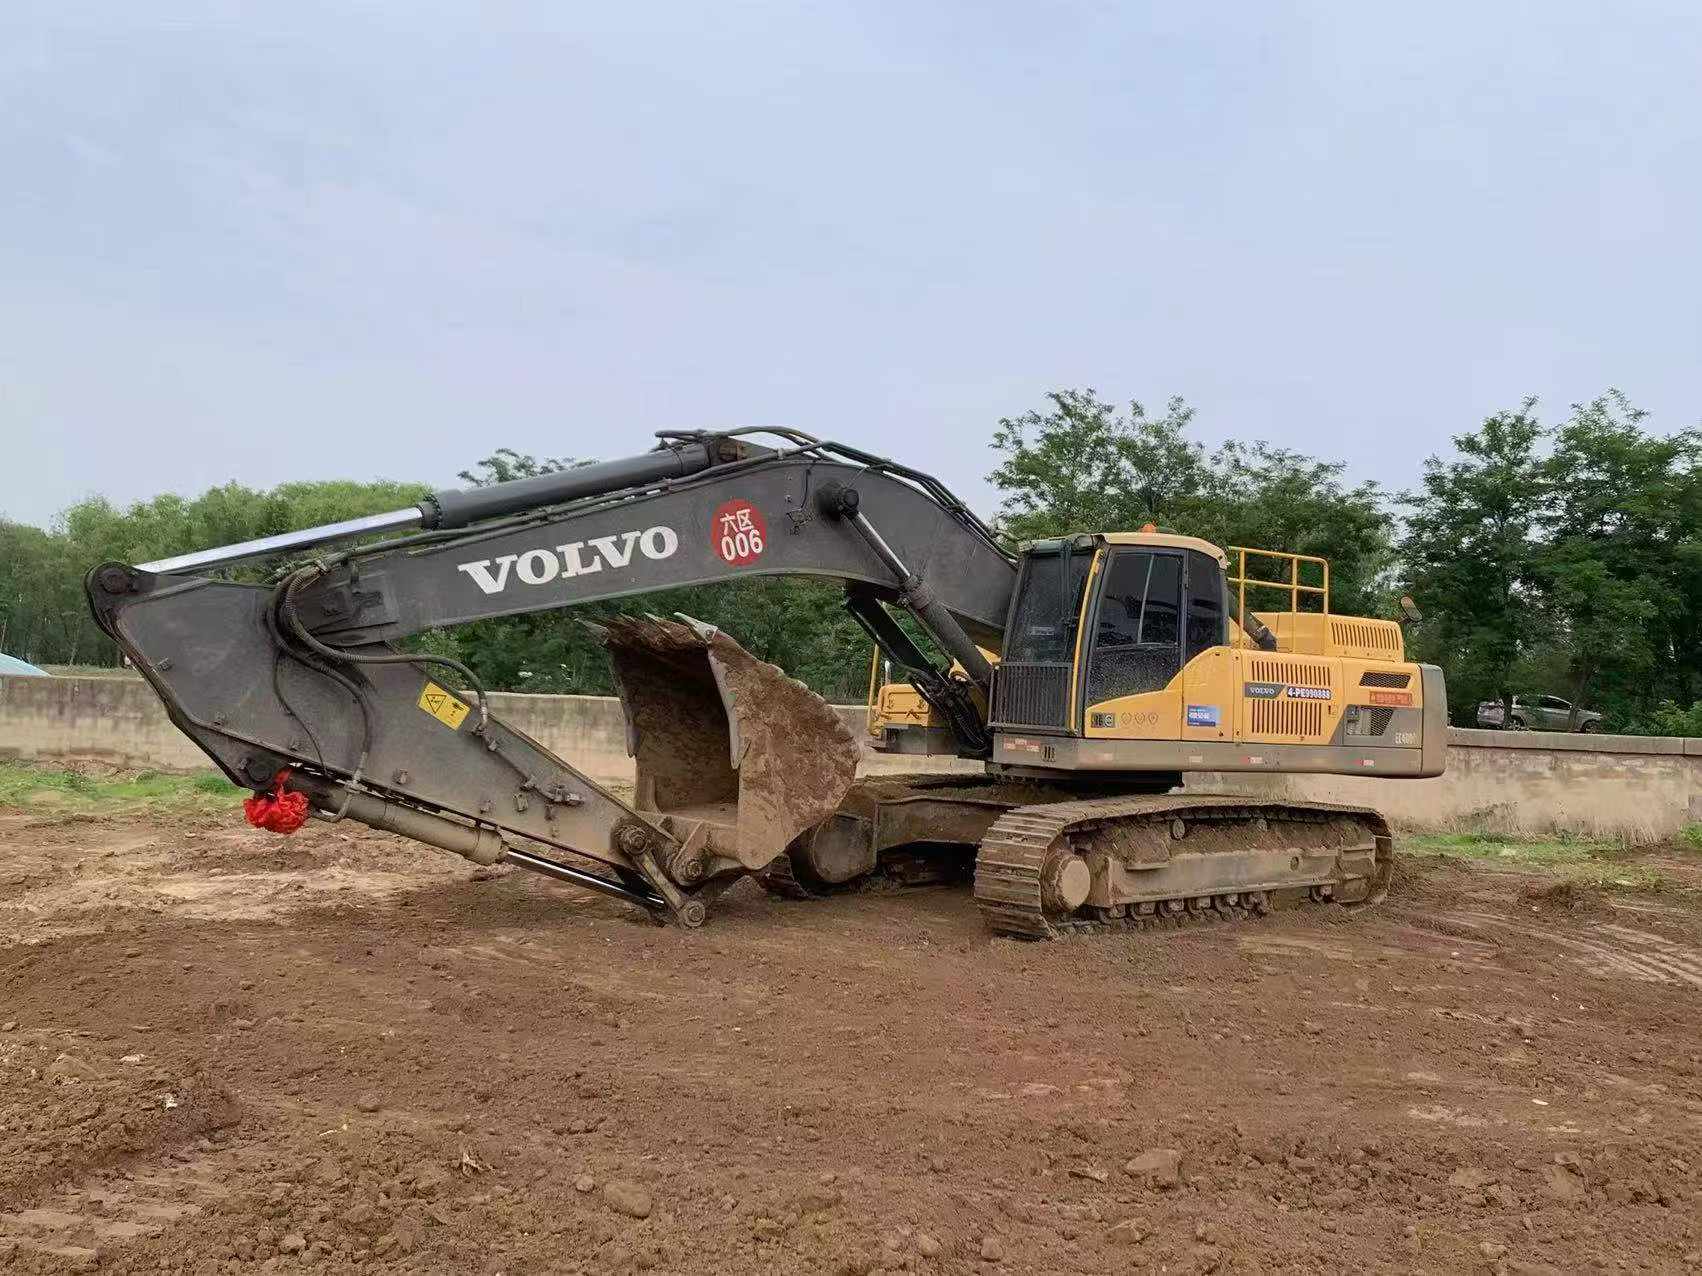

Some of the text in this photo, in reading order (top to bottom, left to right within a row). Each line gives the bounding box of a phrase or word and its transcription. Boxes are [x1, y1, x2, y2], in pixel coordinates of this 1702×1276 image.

[720, 509, 754, 535] 六区
[721, 529, 763, 561] 006
[458, 526, 678, 595] VOLVO
[1250, 686, 1275, 695] VOLVO
